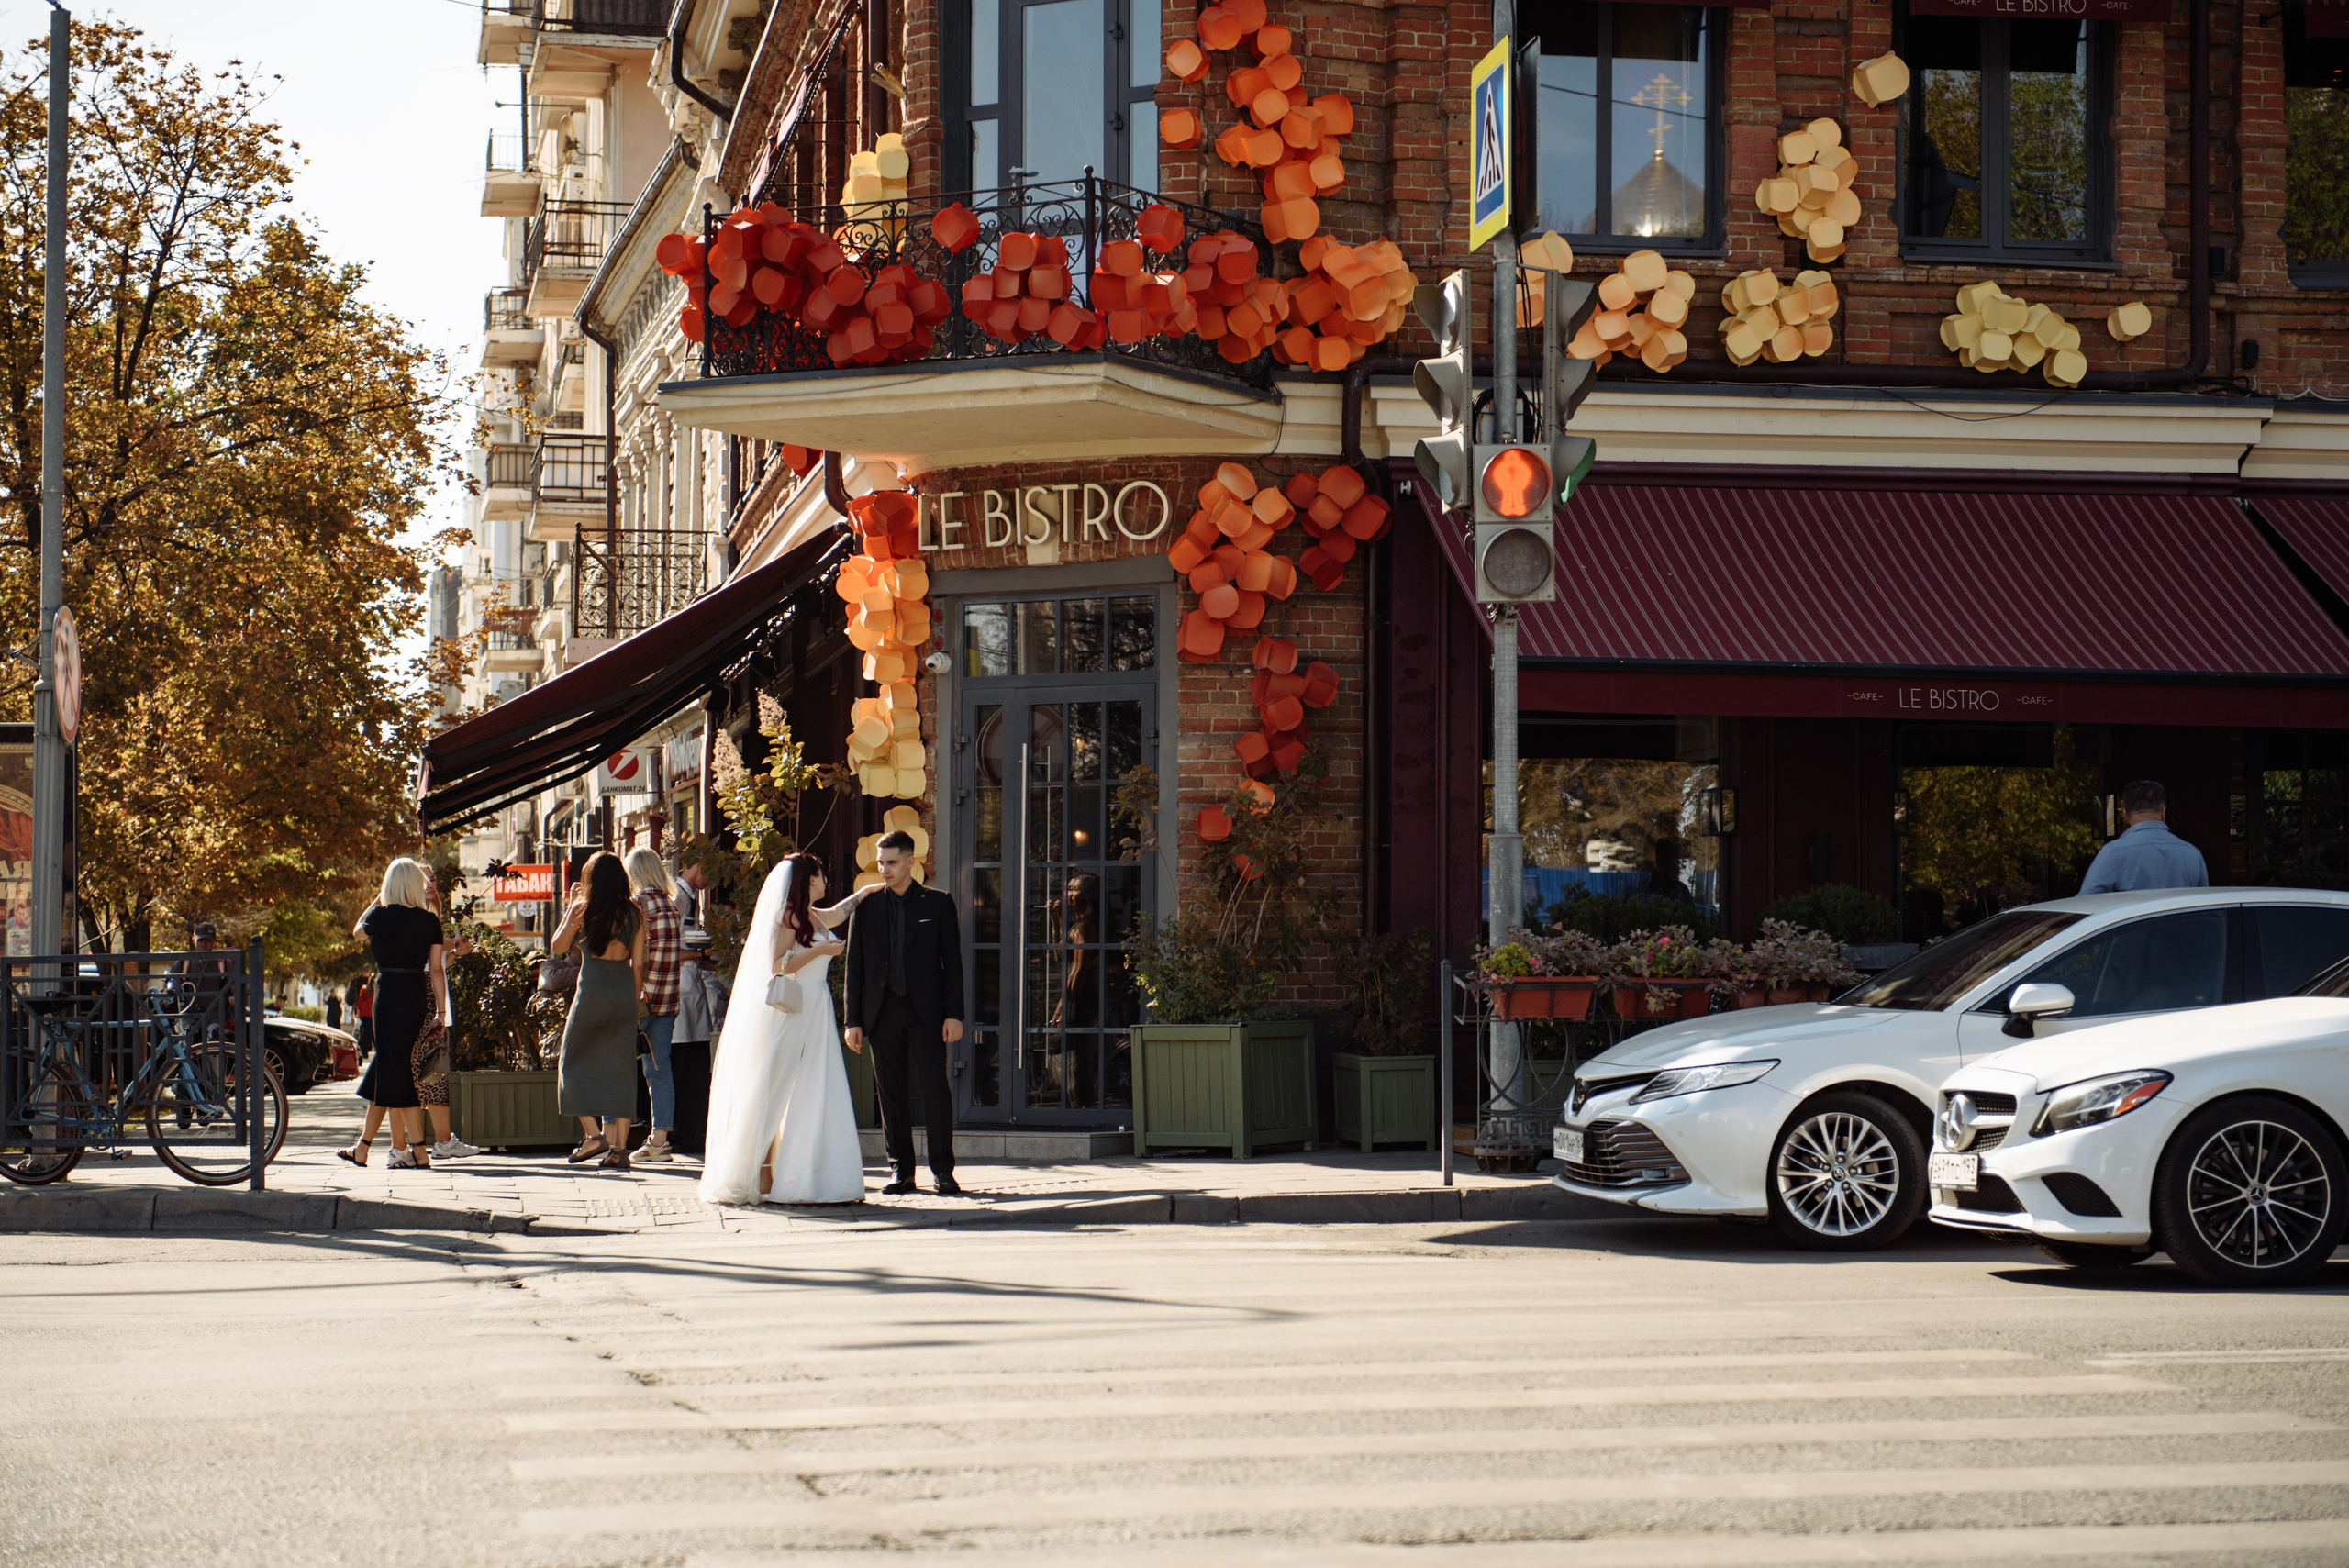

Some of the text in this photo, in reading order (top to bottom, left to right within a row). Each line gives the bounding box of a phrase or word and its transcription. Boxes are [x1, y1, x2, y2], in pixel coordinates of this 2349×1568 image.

[1996, 0, 2017, 12] LE
[2022, 0, 2087, 14] BISTRO
[918, 480, 1172, 551] LE BISTRO
[1898, 688, 1922, 709] LE
[1929, 688, 2000, 711] BISTRO
[601, 785, 638, 794] БАНКОМАТ
[495, 873, 552, 893] ТАБАК
